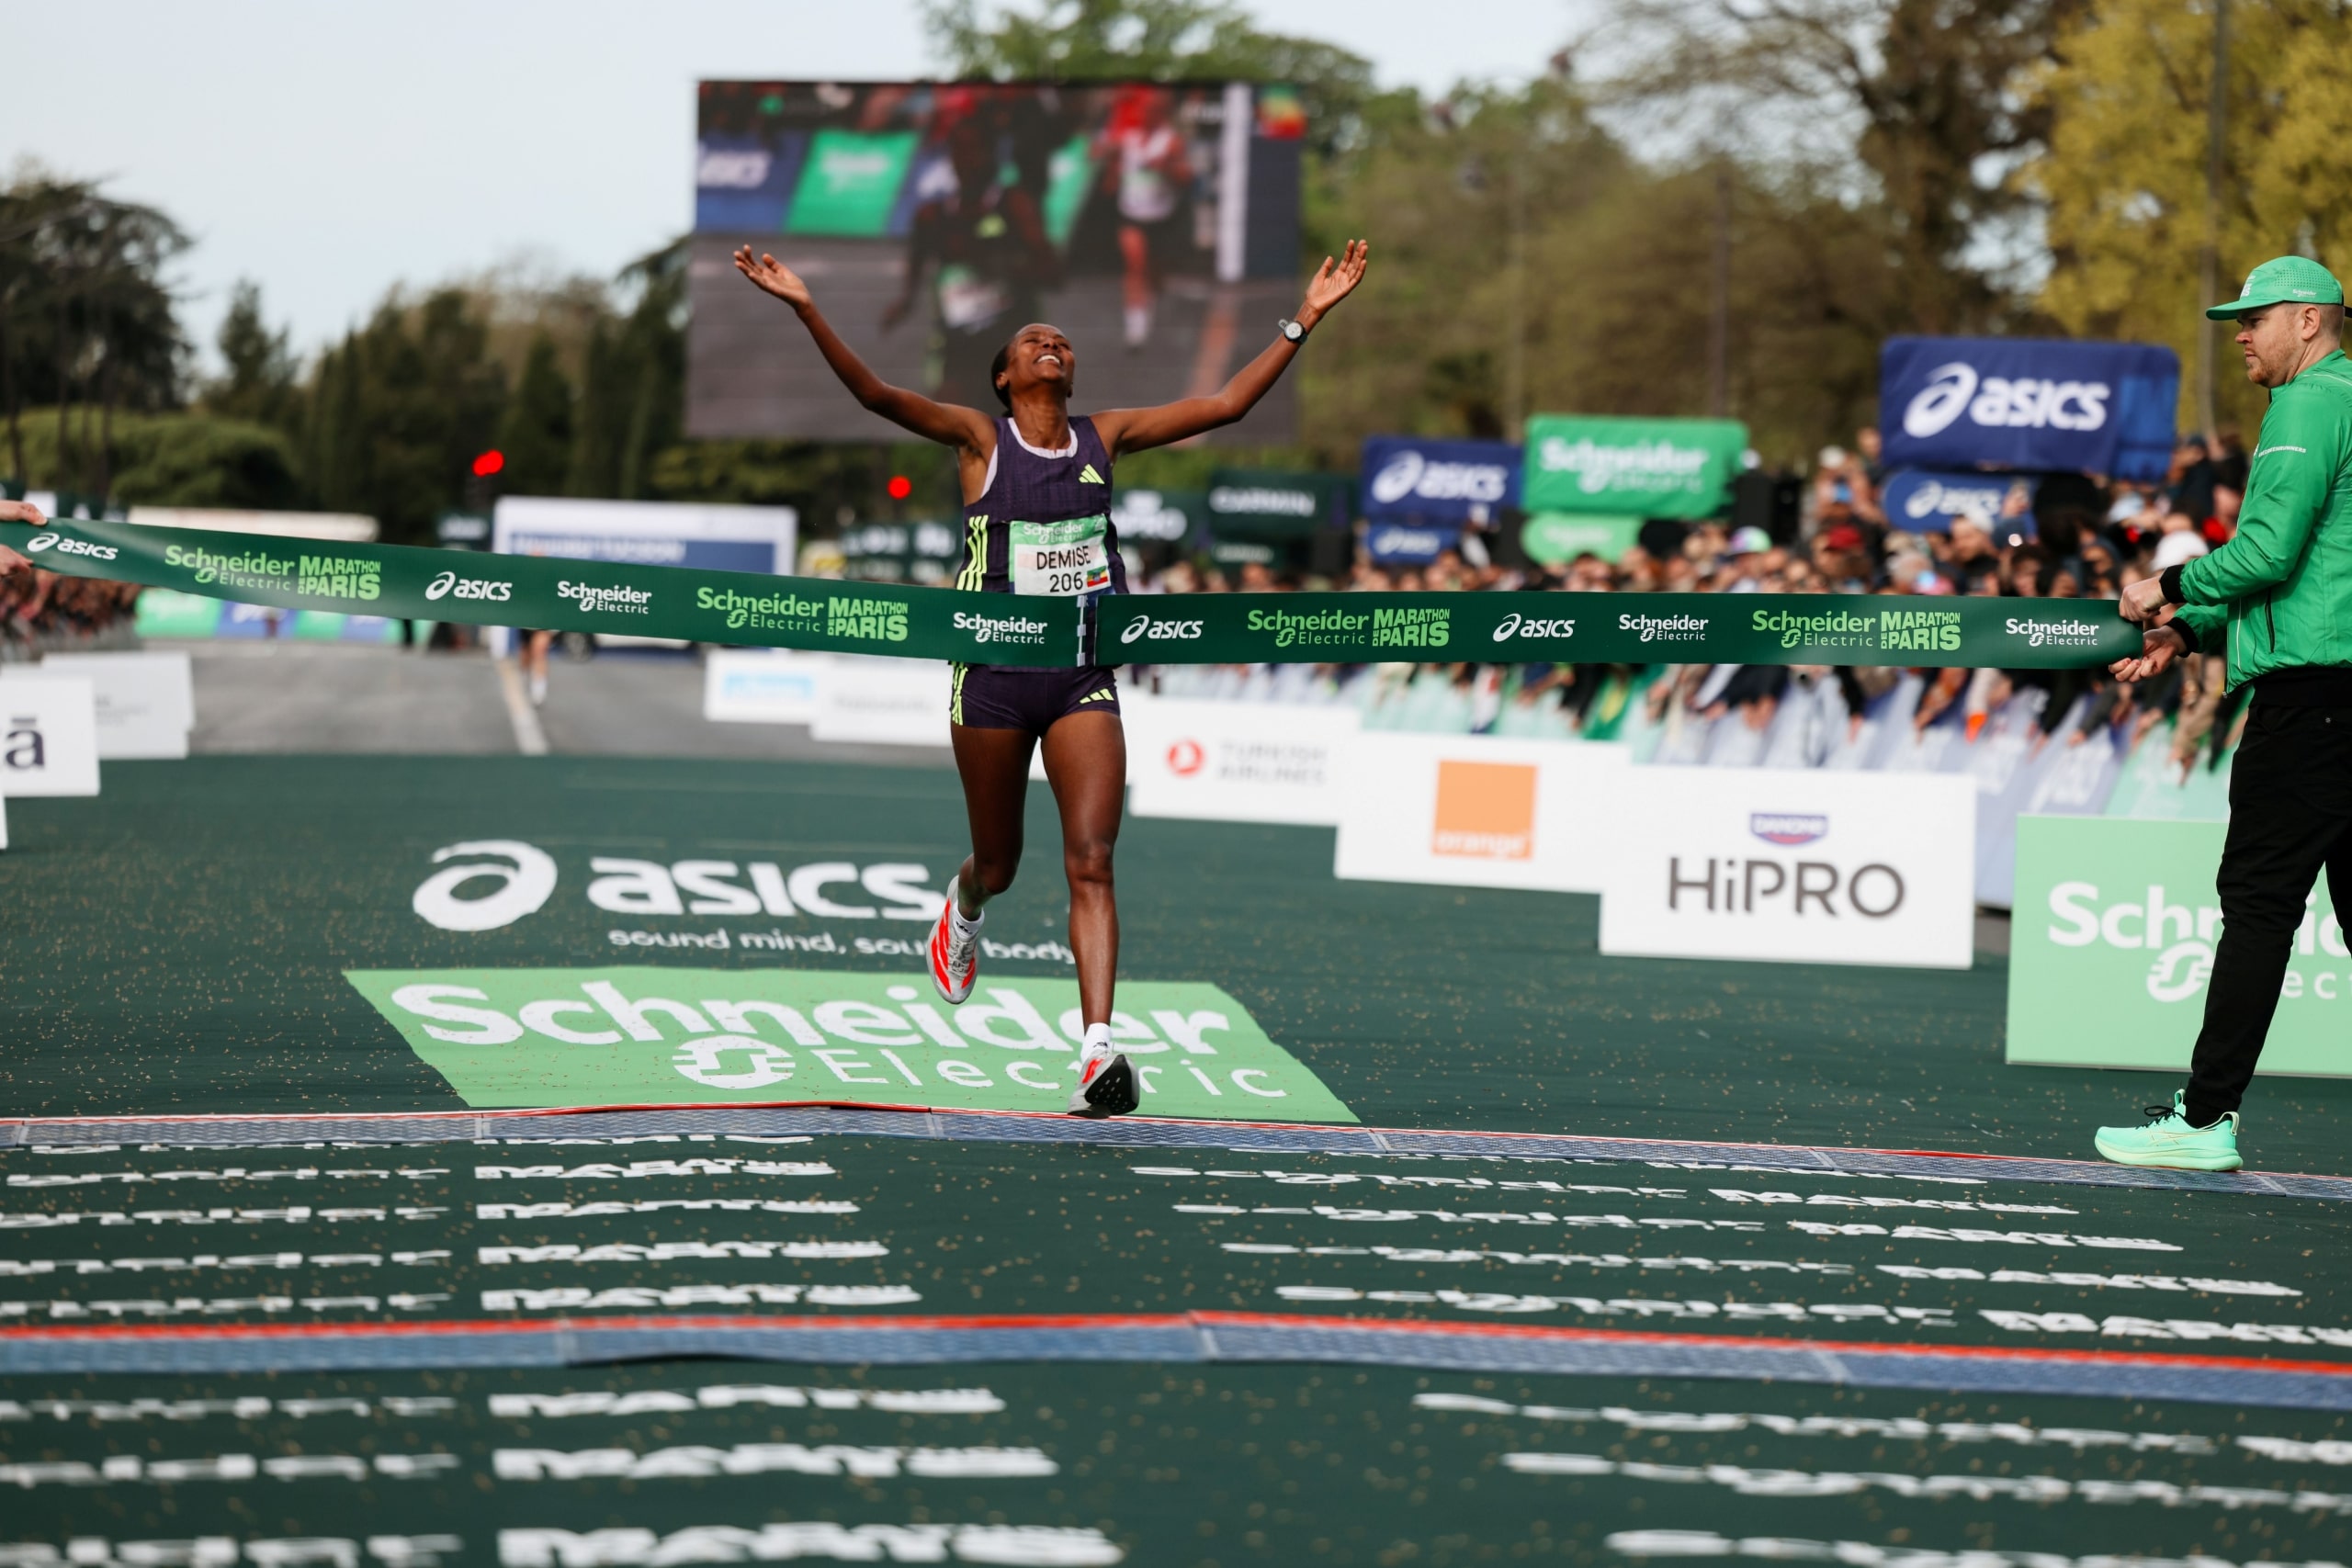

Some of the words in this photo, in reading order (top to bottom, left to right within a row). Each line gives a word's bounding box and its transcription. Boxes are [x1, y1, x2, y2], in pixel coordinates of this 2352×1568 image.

[1970, 377, 2110, 431] asics
[1023, 522, 1085, 536] Schneider
[57, 536, 118, 561] asics
[1036, 546, 1091, 570] DEMISE
[164, 545, 295, 577] Schneider
[299, 555, 380, 576] MARATHON
[219, 573, 290, 592] Electric
[305, 573, 380, 600] PARIS
[453, 579, 512, 602] asics
[558, 581, 652, 604] Schneider
[1049, 572, 1083, 592] 206
[597, 601, 649, 615] Electric
[696, 587, 824, 617] Schneider
[828, 597, 908, 615] MARATHON
[750, 614, 820, 632] Electric
[835, 613, 908, 641] PARIS
[954, 612, 1047, 634] Schneider
[1248, 610, 1368, 632] Schneider
[1374, 608, 1450, 626] MARATHON
[1619, 614, 1709, 633] Schneider
[1752, 610, 1876, 633] Schneider
[1881, 611, 1960, 626] MARATHON
[2006, 618, 2098, 636] Schneider
[992, 631, 1045, 644] Electric
[1148, 620, 1204, 639] asics
[1298, 631, 1365, 646] Electric
[1379, 621, 1449, 647] PARIS
[1520, 619, 1575, 638] asics
[1657, 630, 1706, 642] Electric
[1888, 625, 1961, 651] PARIS
[1804, 632, 1873, 647] Electric
[2046, 634, 2098, 646] Electric
[587, 856, 947, 922] asics
[1668, 855, 1905, 919] HiPRO
[608, 929, 730, 950] sound
[391, 980, 1229, 1055] Schneider
[809, 1048, 1287, 1098] Elecric
